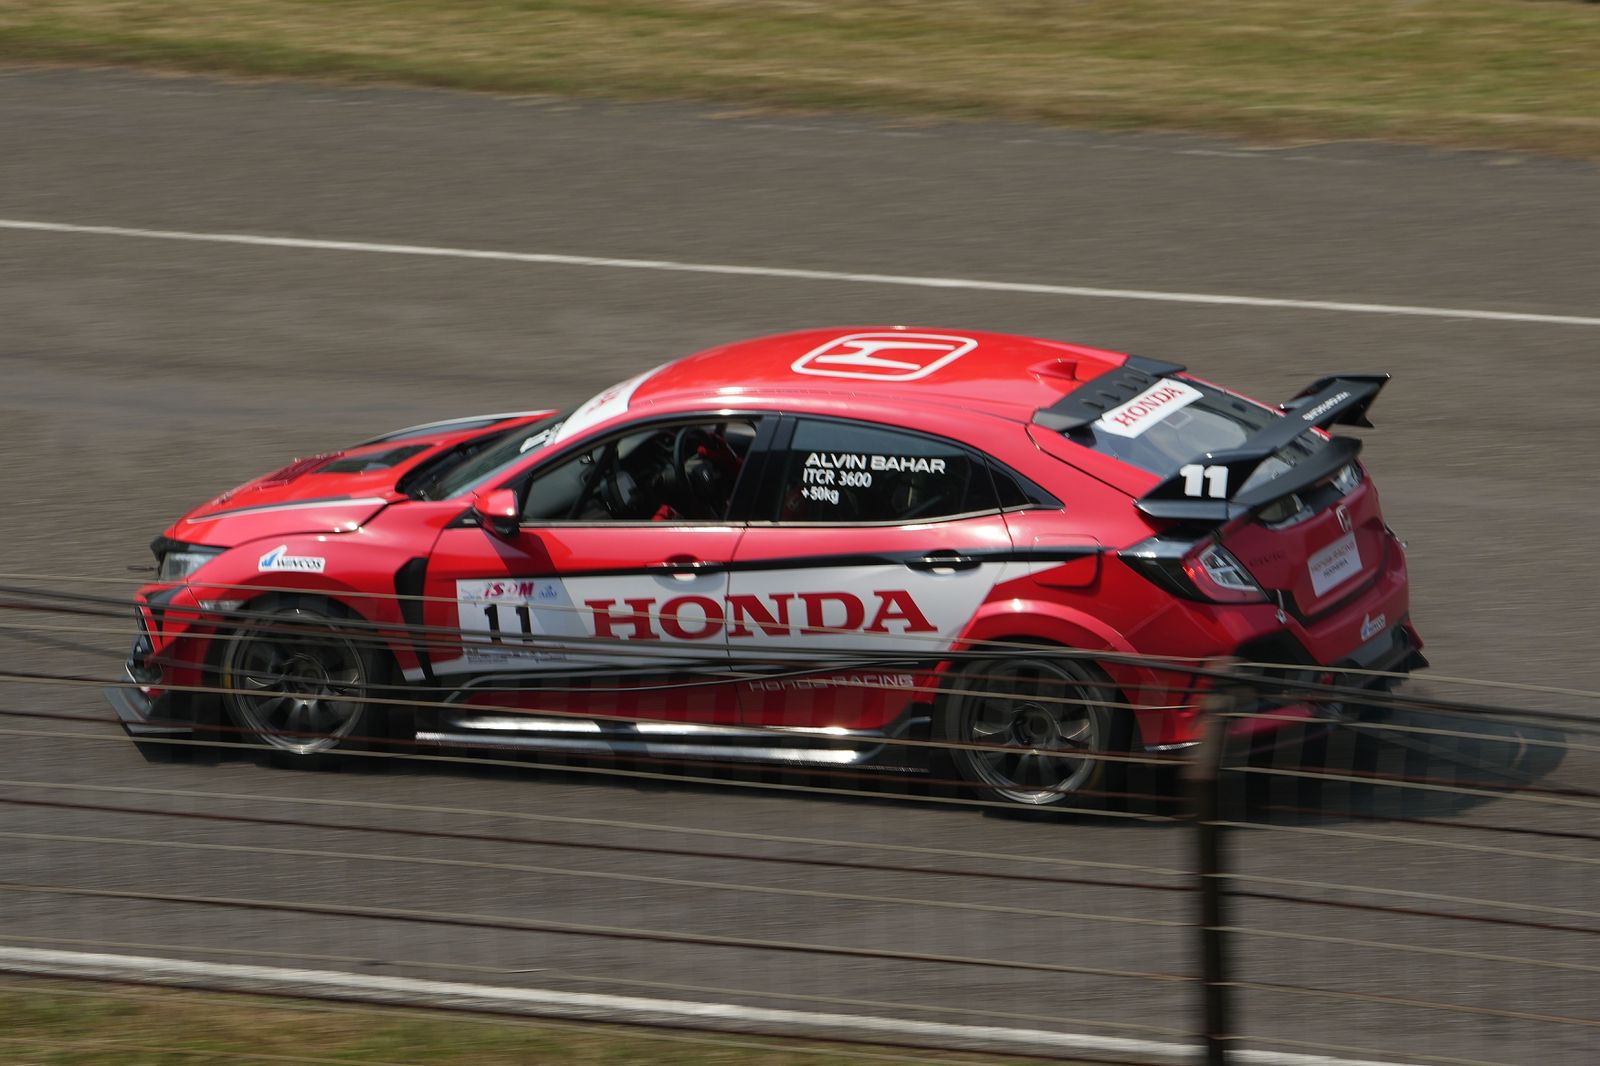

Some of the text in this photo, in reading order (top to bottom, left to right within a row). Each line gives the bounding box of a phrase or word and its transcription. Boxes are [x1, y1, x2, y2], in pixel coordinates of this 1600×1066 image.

[1112, 386, 1185, 428] HONDA
[802, 467, 873, 488] ITCR 3600
[804, 452, 946, 475] ALVIN BAHAR
[1179, 463, 1230, 500] 11
[484, 602, 535, 646] 11
[583, 589, 941, 641] HONDA
[832, 673, 915, 690] RACING
